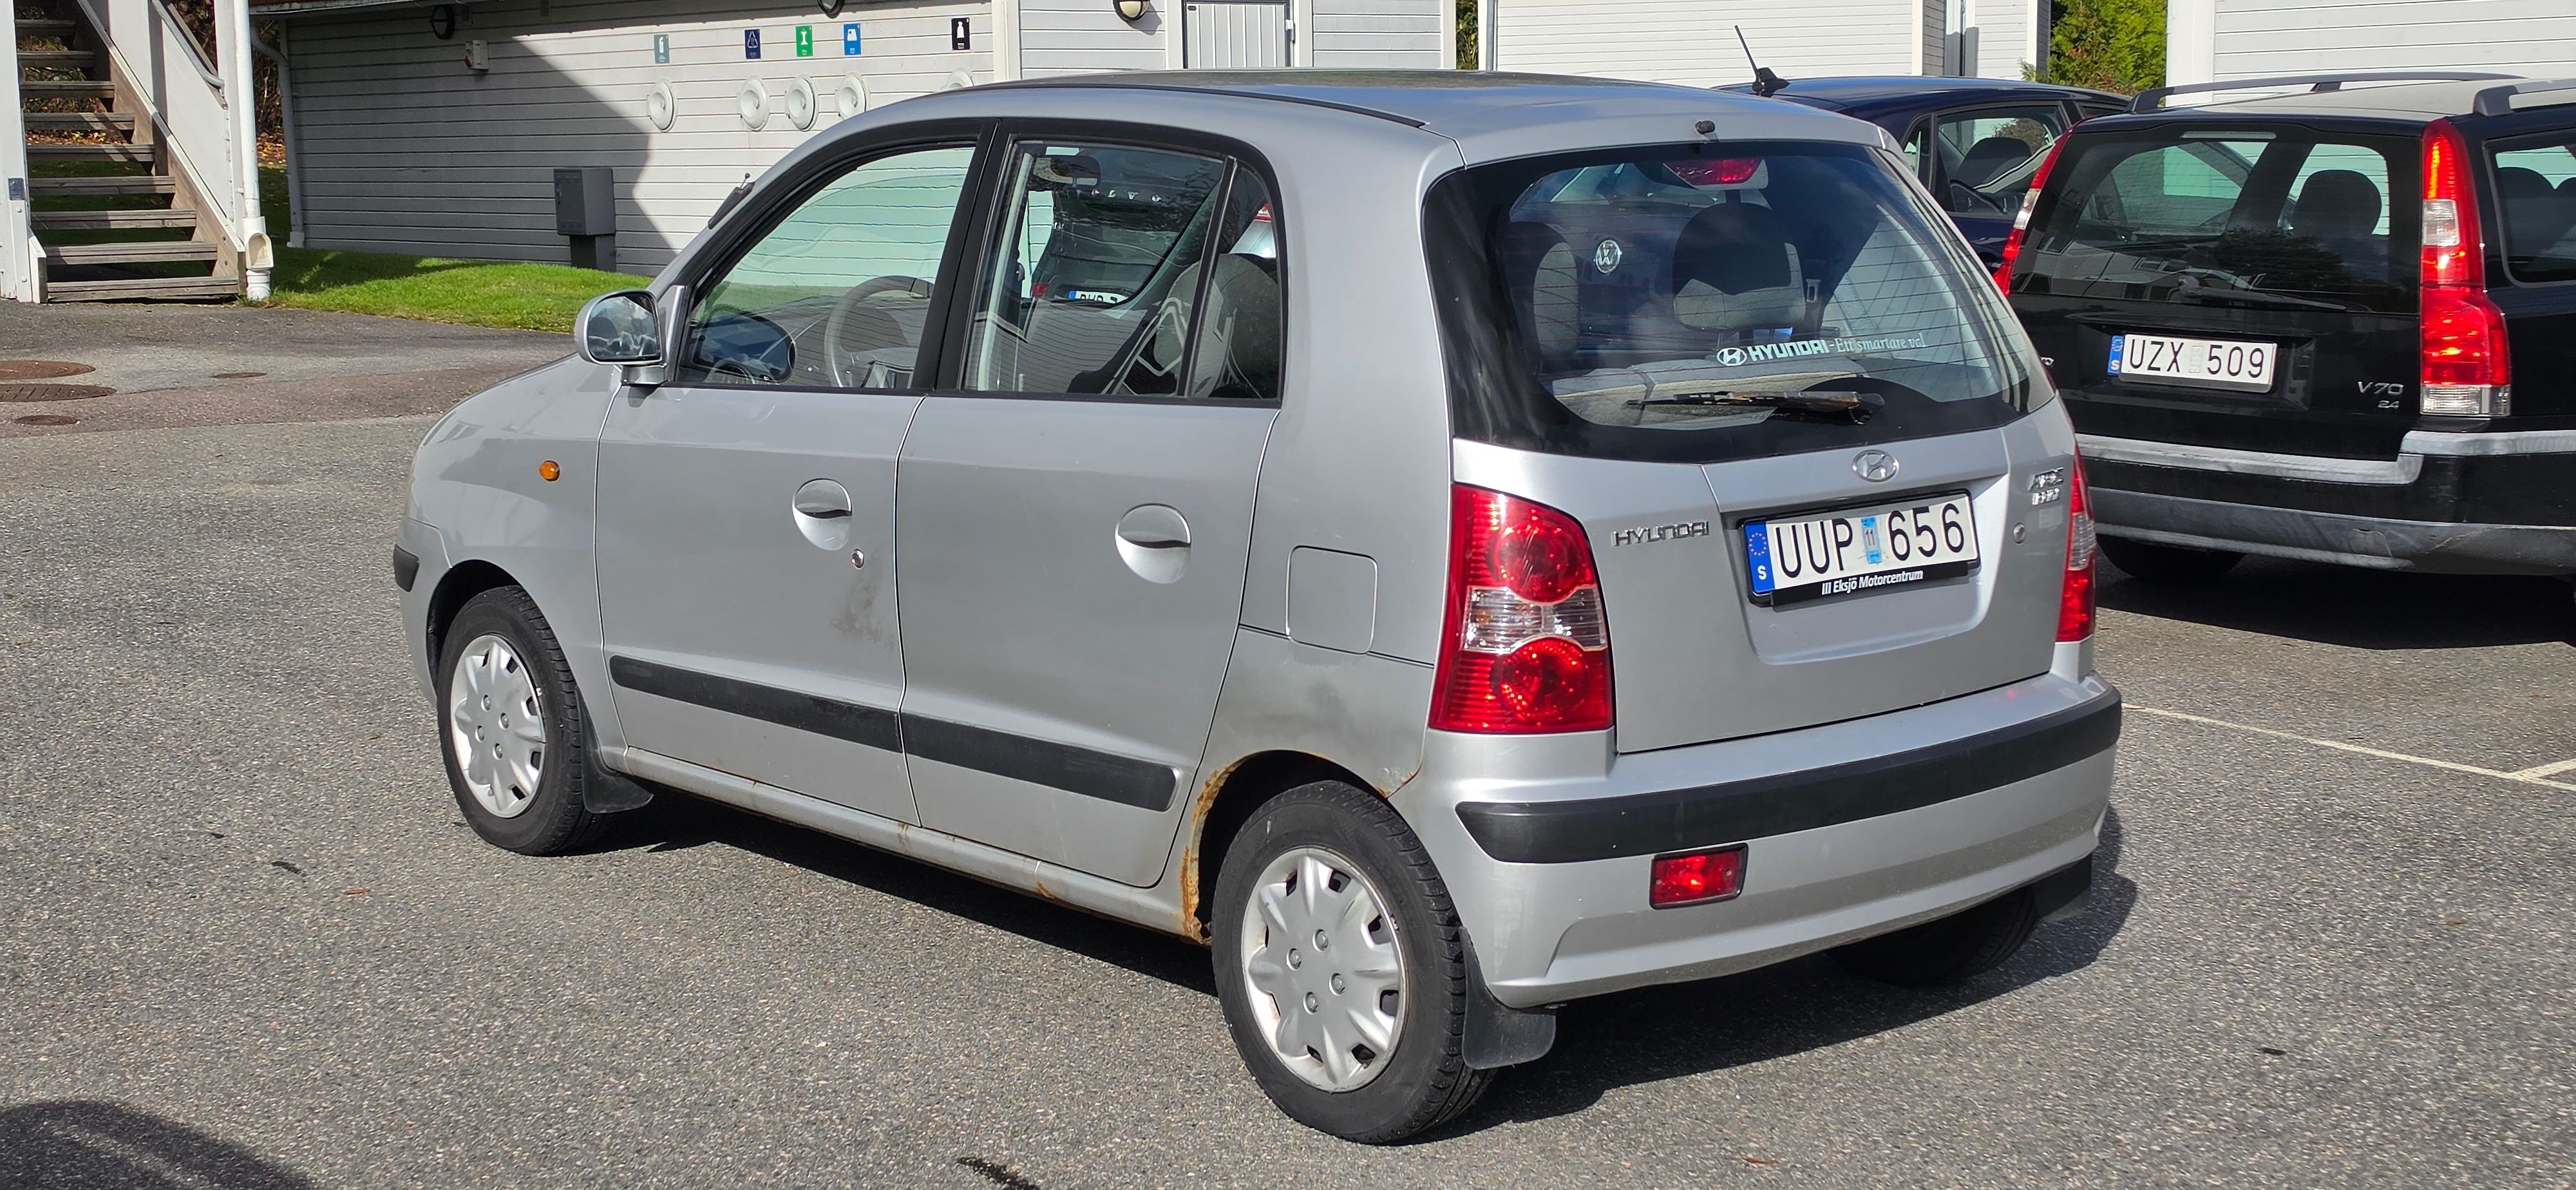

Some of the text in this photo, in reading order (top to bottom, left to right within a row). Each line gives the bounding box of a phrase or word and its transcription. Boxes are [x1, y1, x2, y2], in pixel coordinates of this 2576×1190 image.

[1747, 339, 1830, 361] HYUNDAI
[1857, 335, 1907, 352] smartare
[2130, 339, 2264, 378] UZX 509
[2110, 359, 2120, 370] S
[1611, 520, 1710, 547] HYUNDAI
[1775, 503, 1964, 578] UUP 656
[1758, 565, 1767, 580] S
[1833, 577, 1858, 593] Eksjö
[1859, 570, 1924, 589] Motorcentrum
